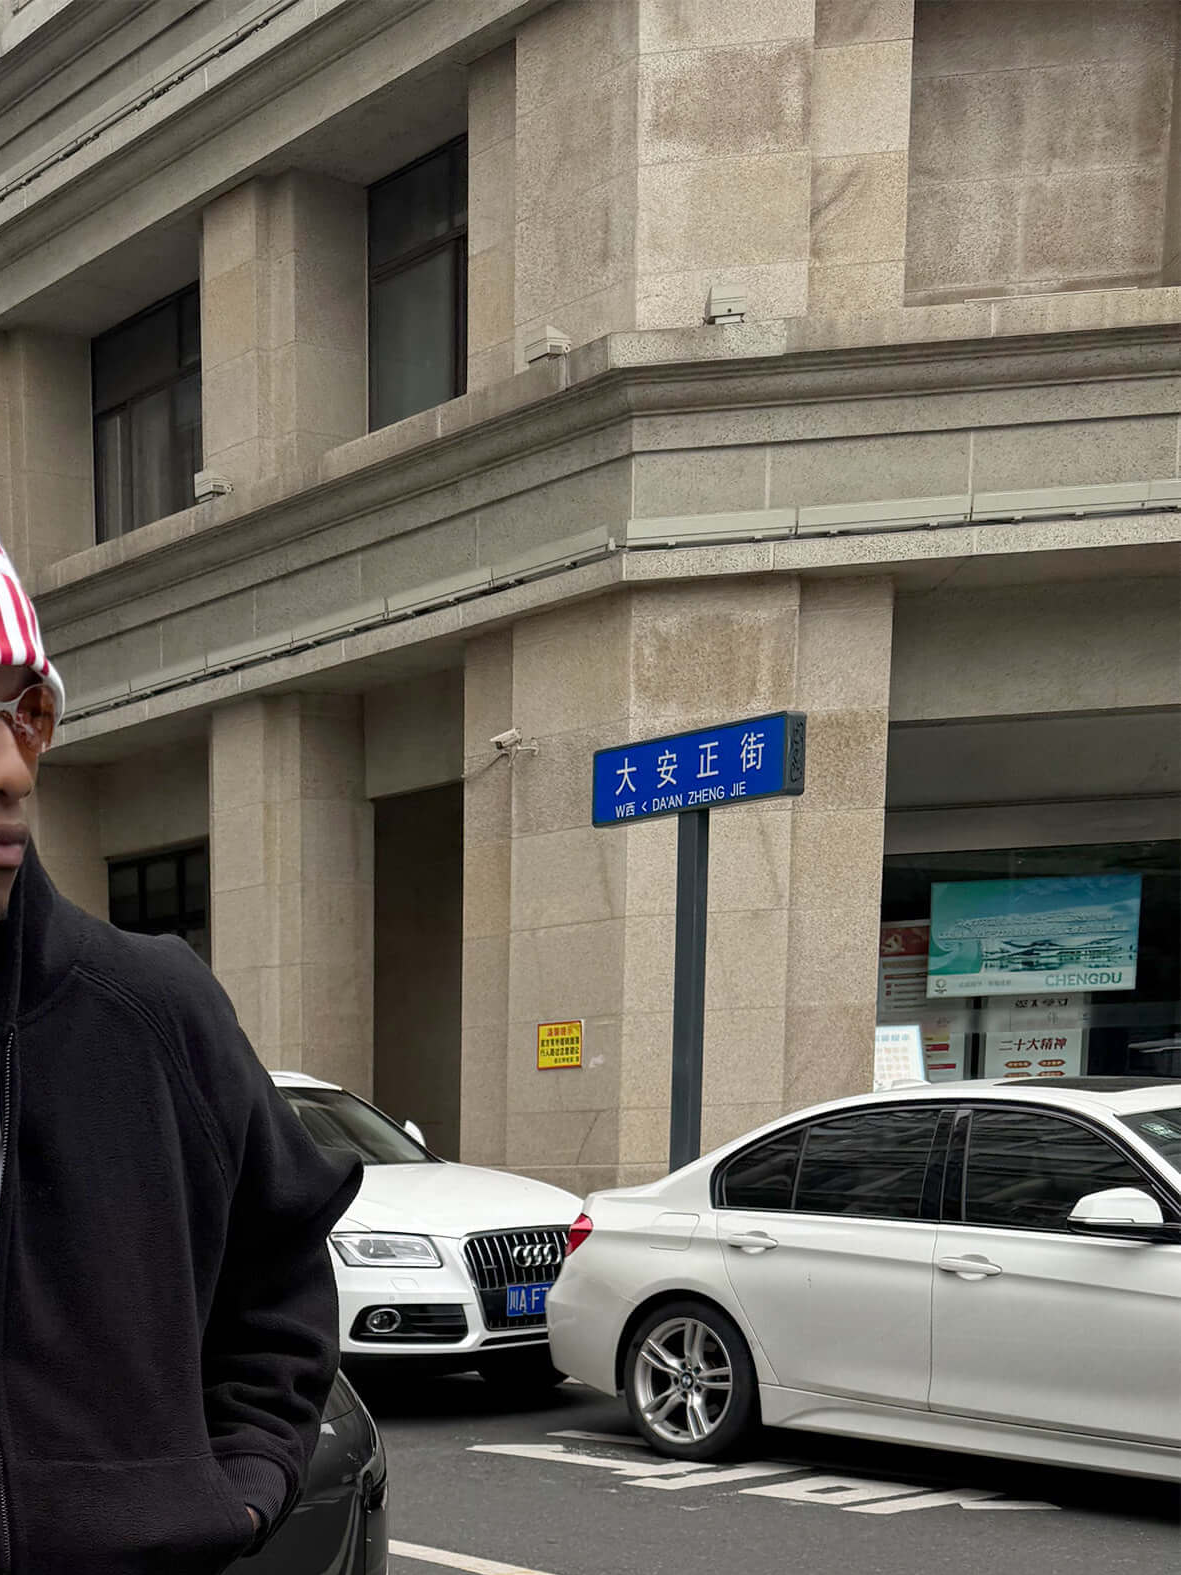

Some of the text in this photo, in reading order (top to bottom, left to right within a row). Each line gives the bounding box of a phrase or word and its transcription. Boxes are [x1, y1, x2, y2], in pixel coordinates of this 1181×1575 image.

[615, 732, 765, 796] 大安正街
[652, 794, 683, 812] DA'AN
[687, 785, 725, 805] ZHENG
[730, 781, 747, 797] JIE
[1045, 972, 1123, 986] CHENGDU
[999, 1037, 1068, 1051] 二十大精神
